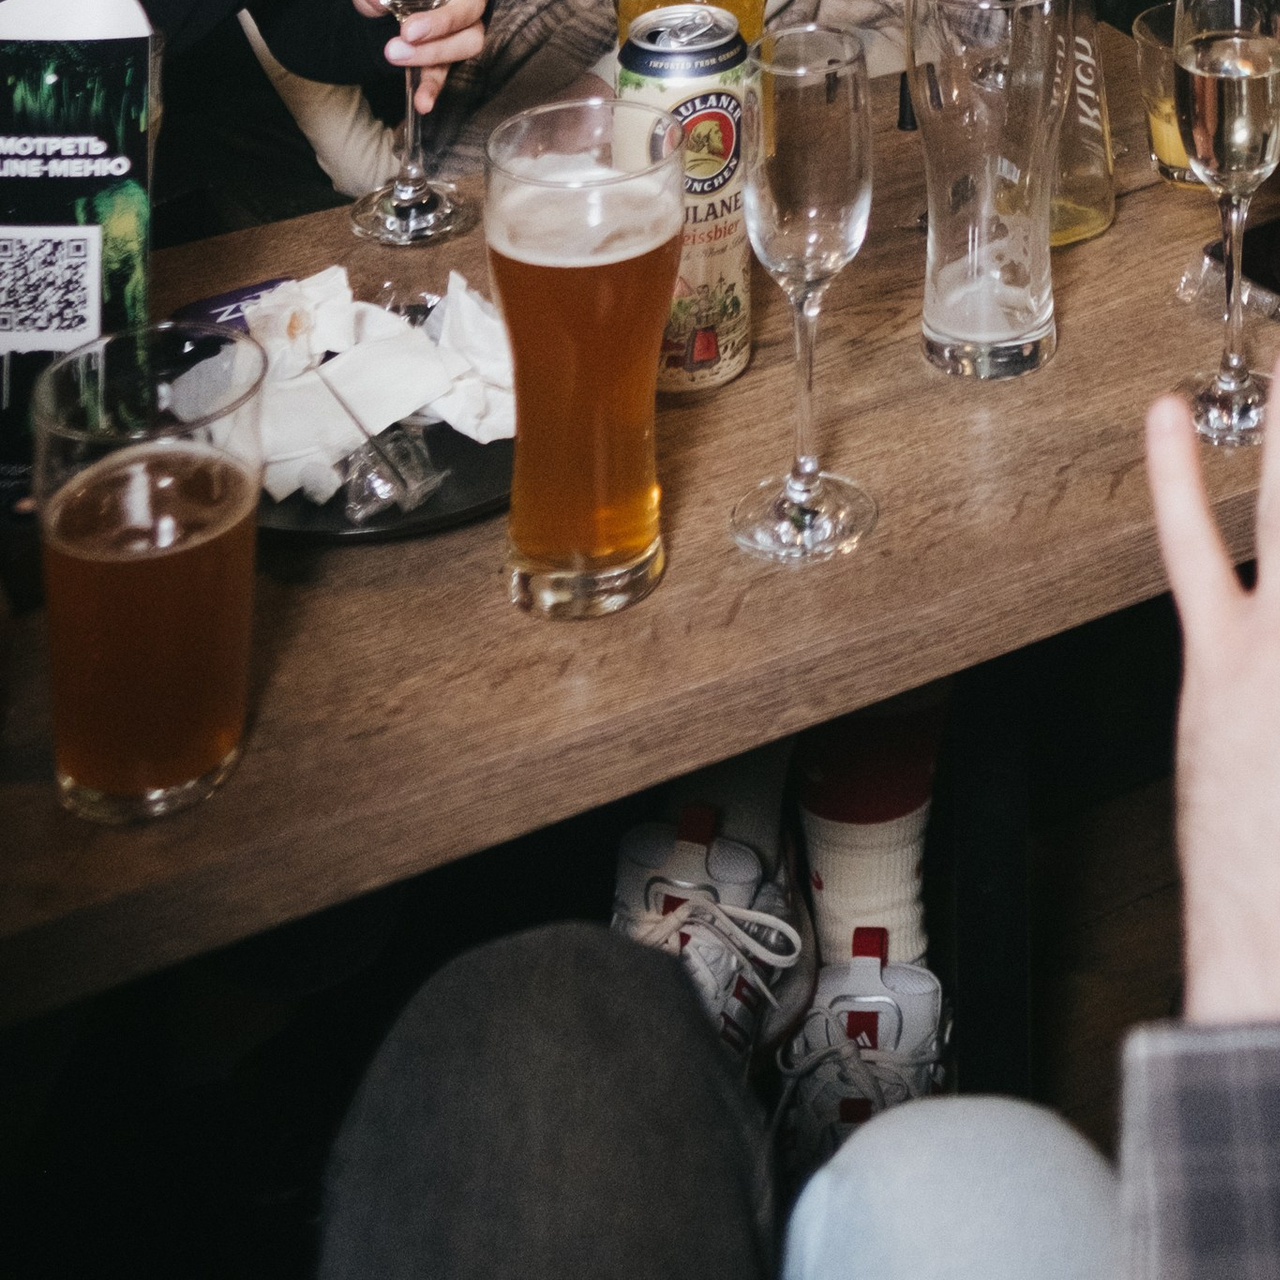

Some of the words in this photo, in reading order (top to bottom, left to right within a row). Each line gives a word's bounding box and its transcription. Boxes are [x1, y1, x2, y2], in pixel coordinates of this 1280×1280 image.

[649, 59, 692, 71] IMPORTED
[694, 57, 716, 68] FROM
[0, 136, 108, 156] МОТРЕТЬ
[683, 219, 741, 246] eissbier
